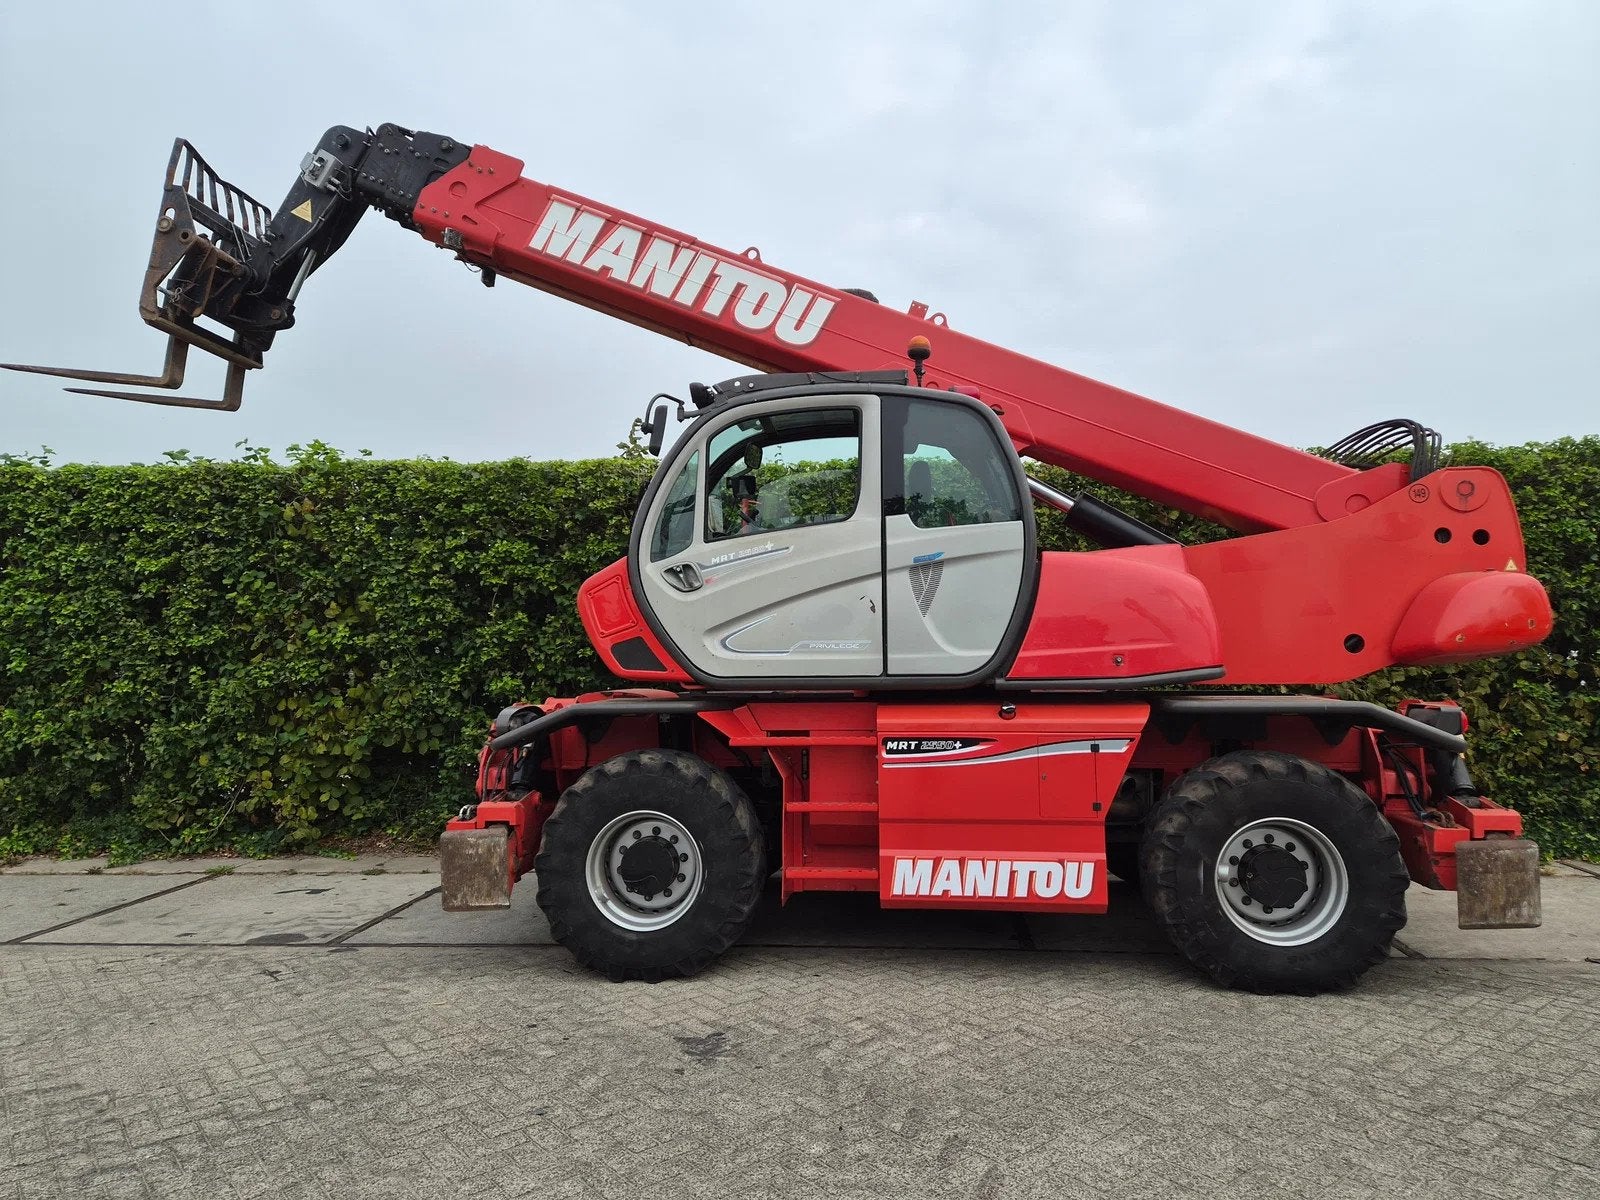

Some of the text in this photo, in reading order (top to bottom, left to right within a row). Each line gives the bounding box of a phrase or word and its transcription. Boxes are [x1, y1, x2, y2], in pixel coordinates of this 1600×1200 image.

[528, 196, 839, 346] MANITOU
[1412, 488, 1426, 498] 149
[711, 552, 736, 565] MRT
[886, 741, 918, 750] MRT
[891, 858, 1095, 899] MANITOU
